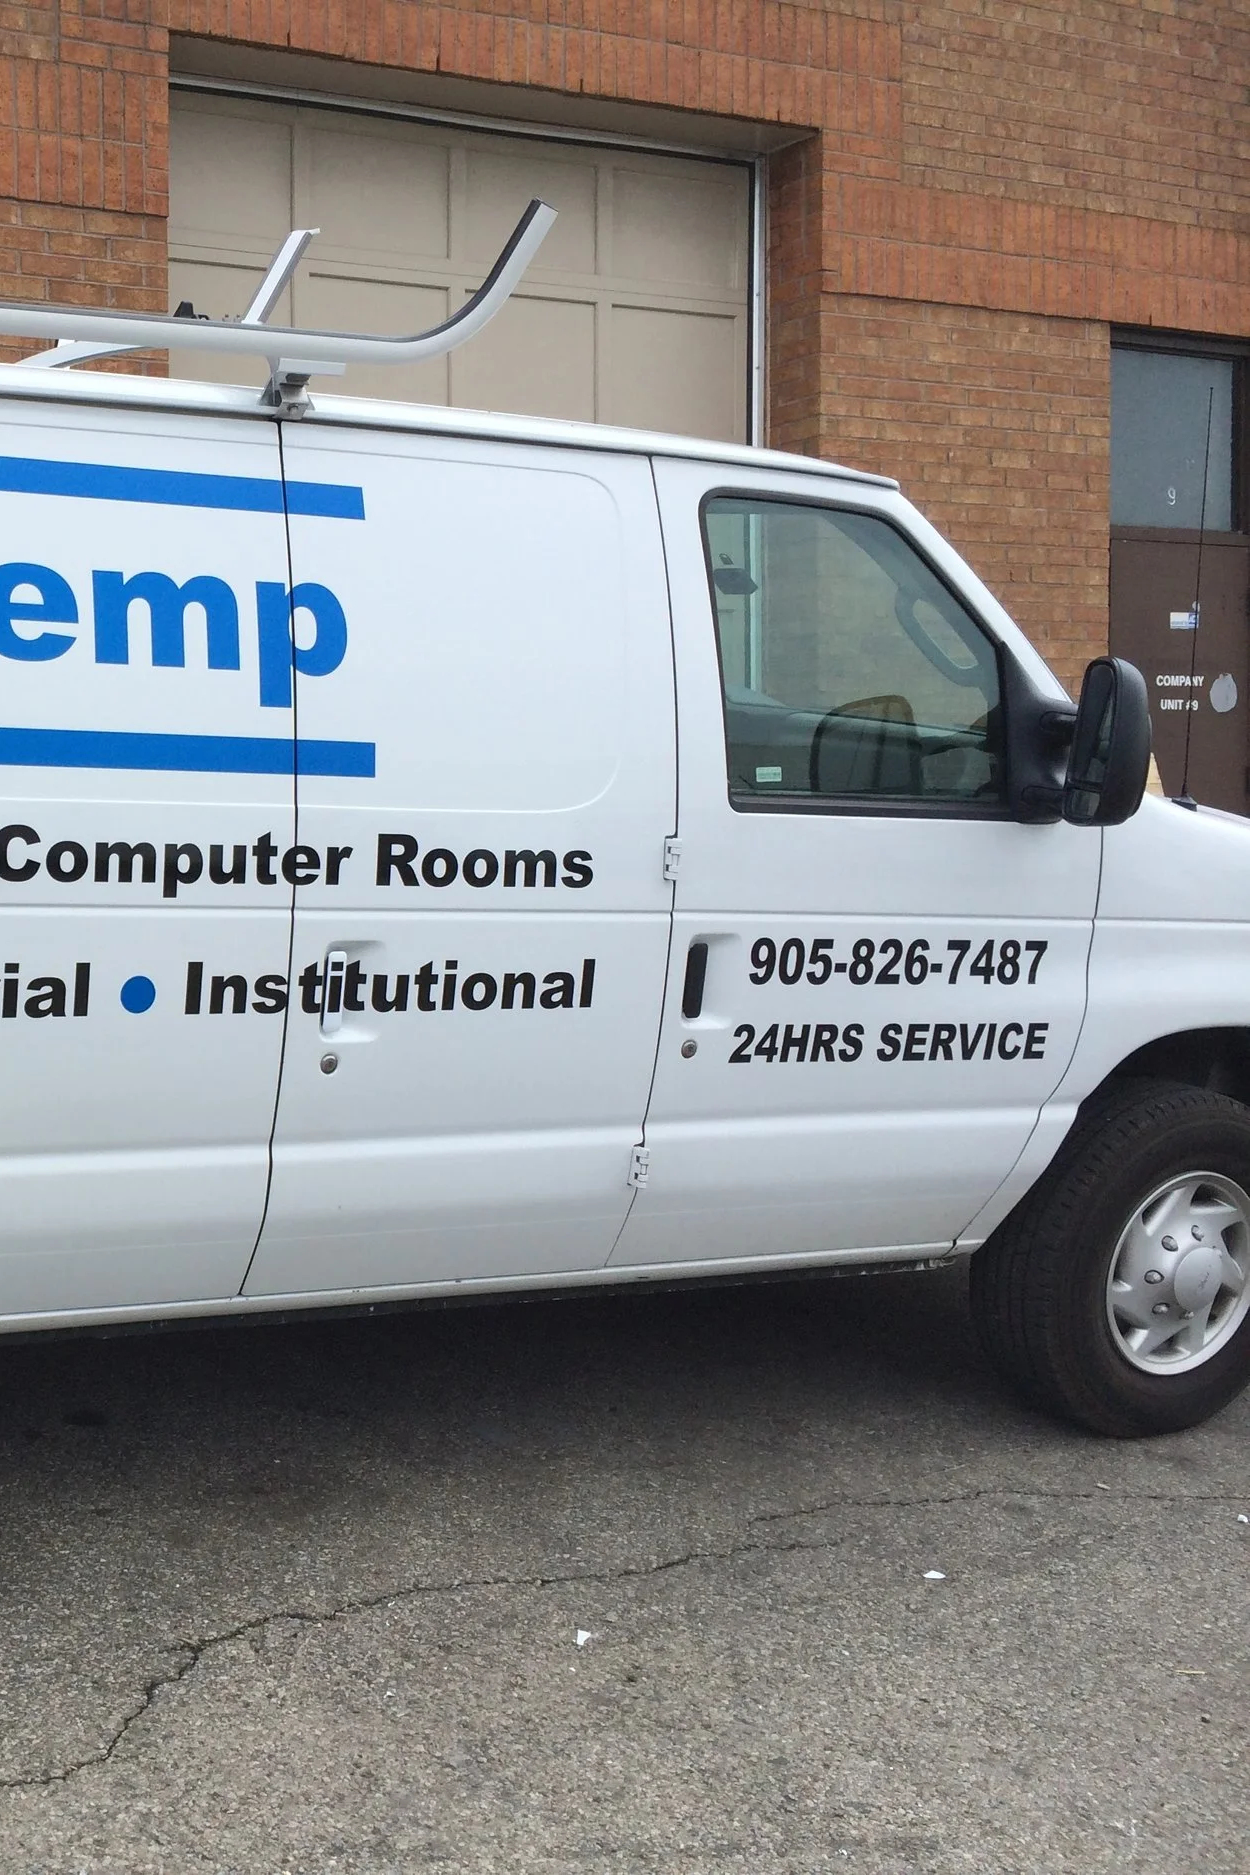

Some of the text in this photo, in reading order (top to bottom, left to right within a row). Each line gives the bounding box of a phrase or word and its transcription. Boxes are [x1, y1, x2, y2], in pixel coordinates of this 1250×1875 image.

[1156, 674, 1205, 687] COMPANY
[1160, 698, 1184, 711] UNIT
[375, 833, 594, 889] Rooms
[748, 937, 1049, 986] 905-826-7487
[183, 958, 596, 1016] Institutional
[728, 1022, 1049, 1064] 24HRS SERVICE
